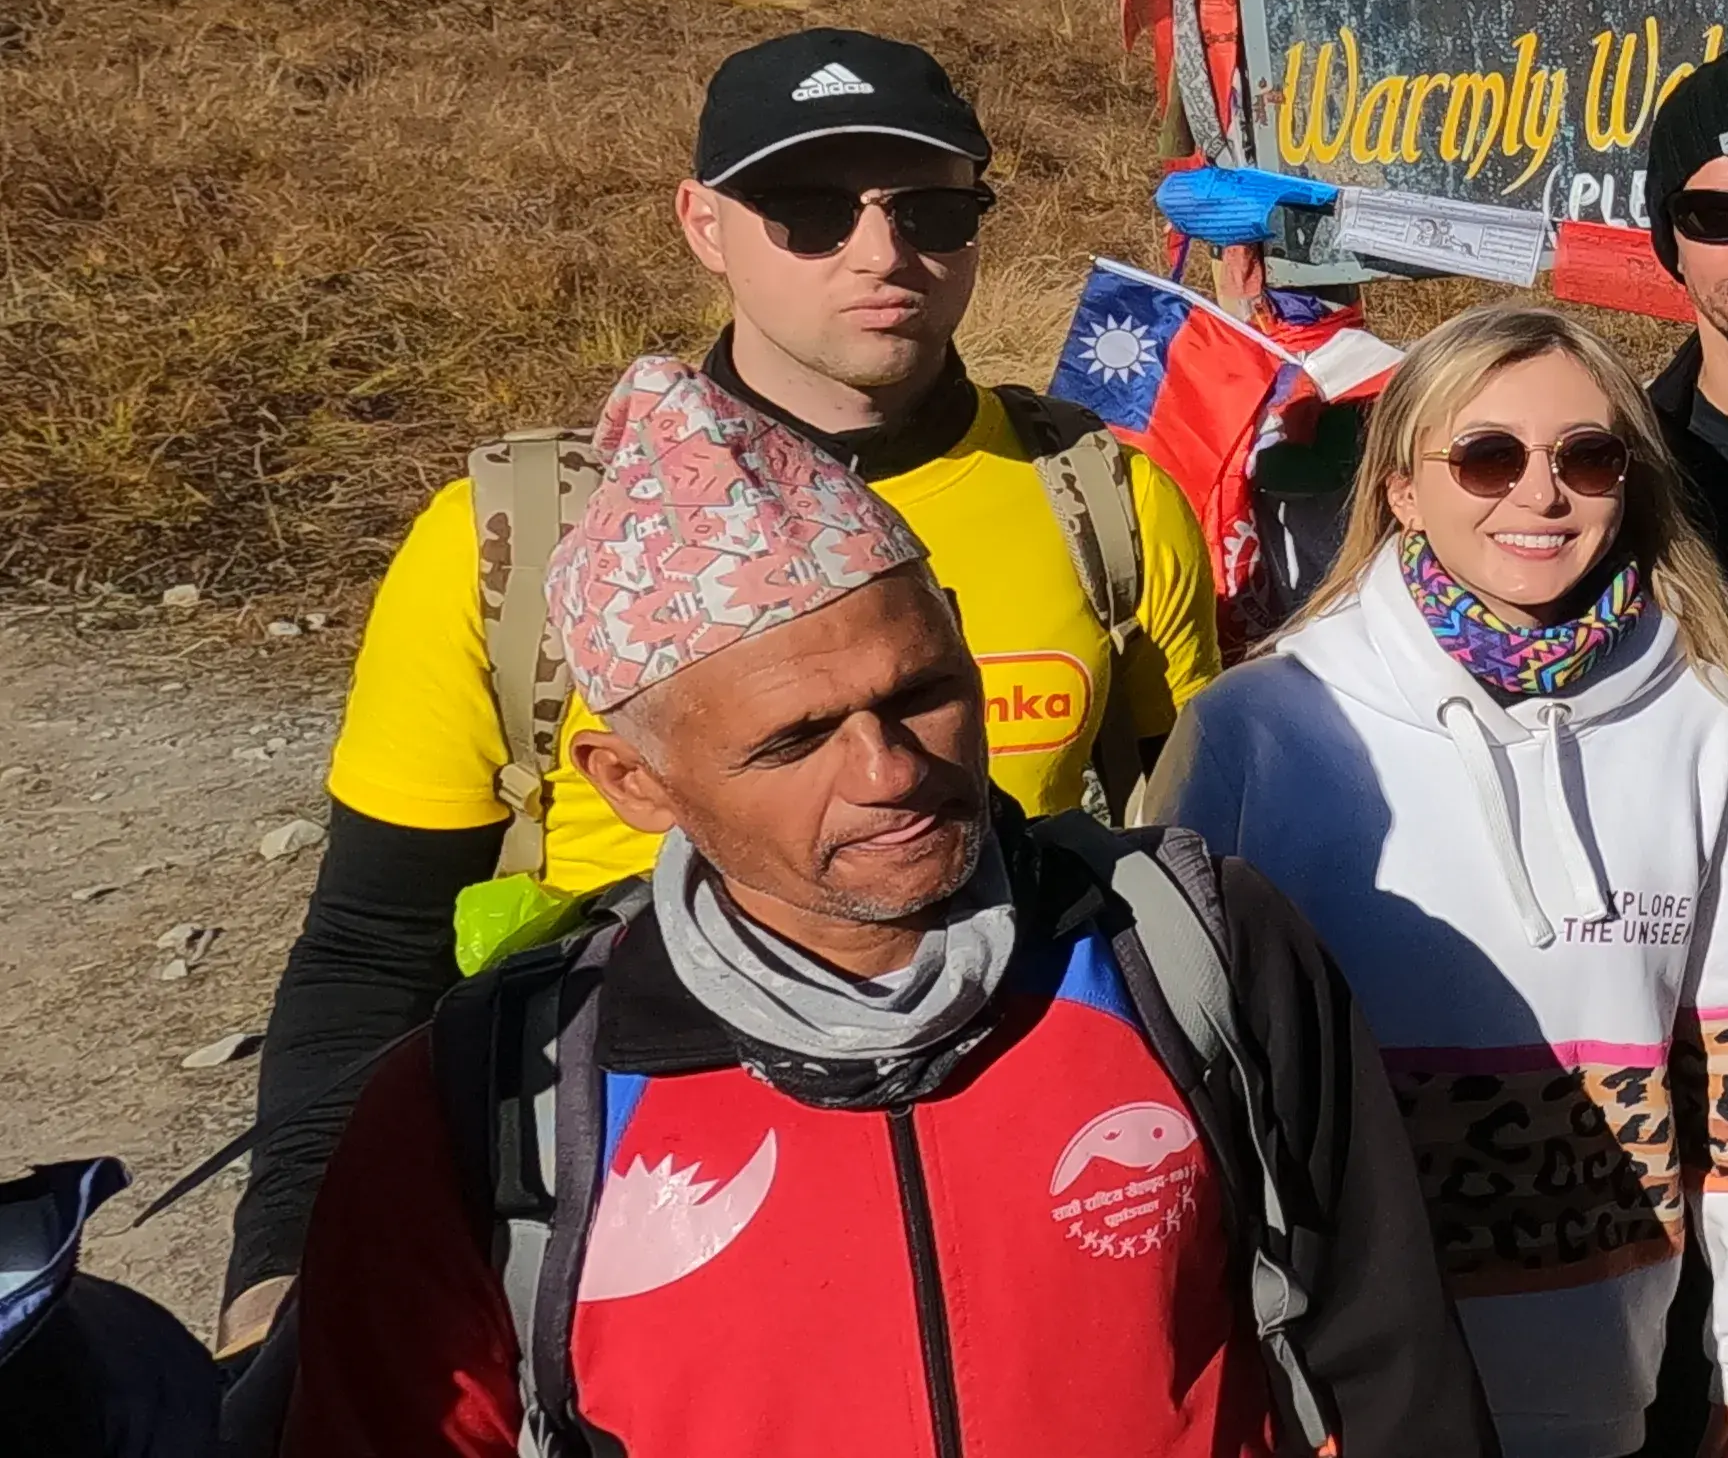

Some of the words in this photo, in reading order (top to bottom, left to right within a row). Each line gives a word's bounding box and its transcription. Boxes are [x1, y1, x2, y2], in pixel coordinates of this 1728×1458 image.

[791, 81, 875, 102] adidas
[1276, 25, 1567, 195] Warmly
[984, 685, 1071, 722] nka
[1606, 889, 1693, 919] XPLORE
[1563, 917, 1614, 943] THE
